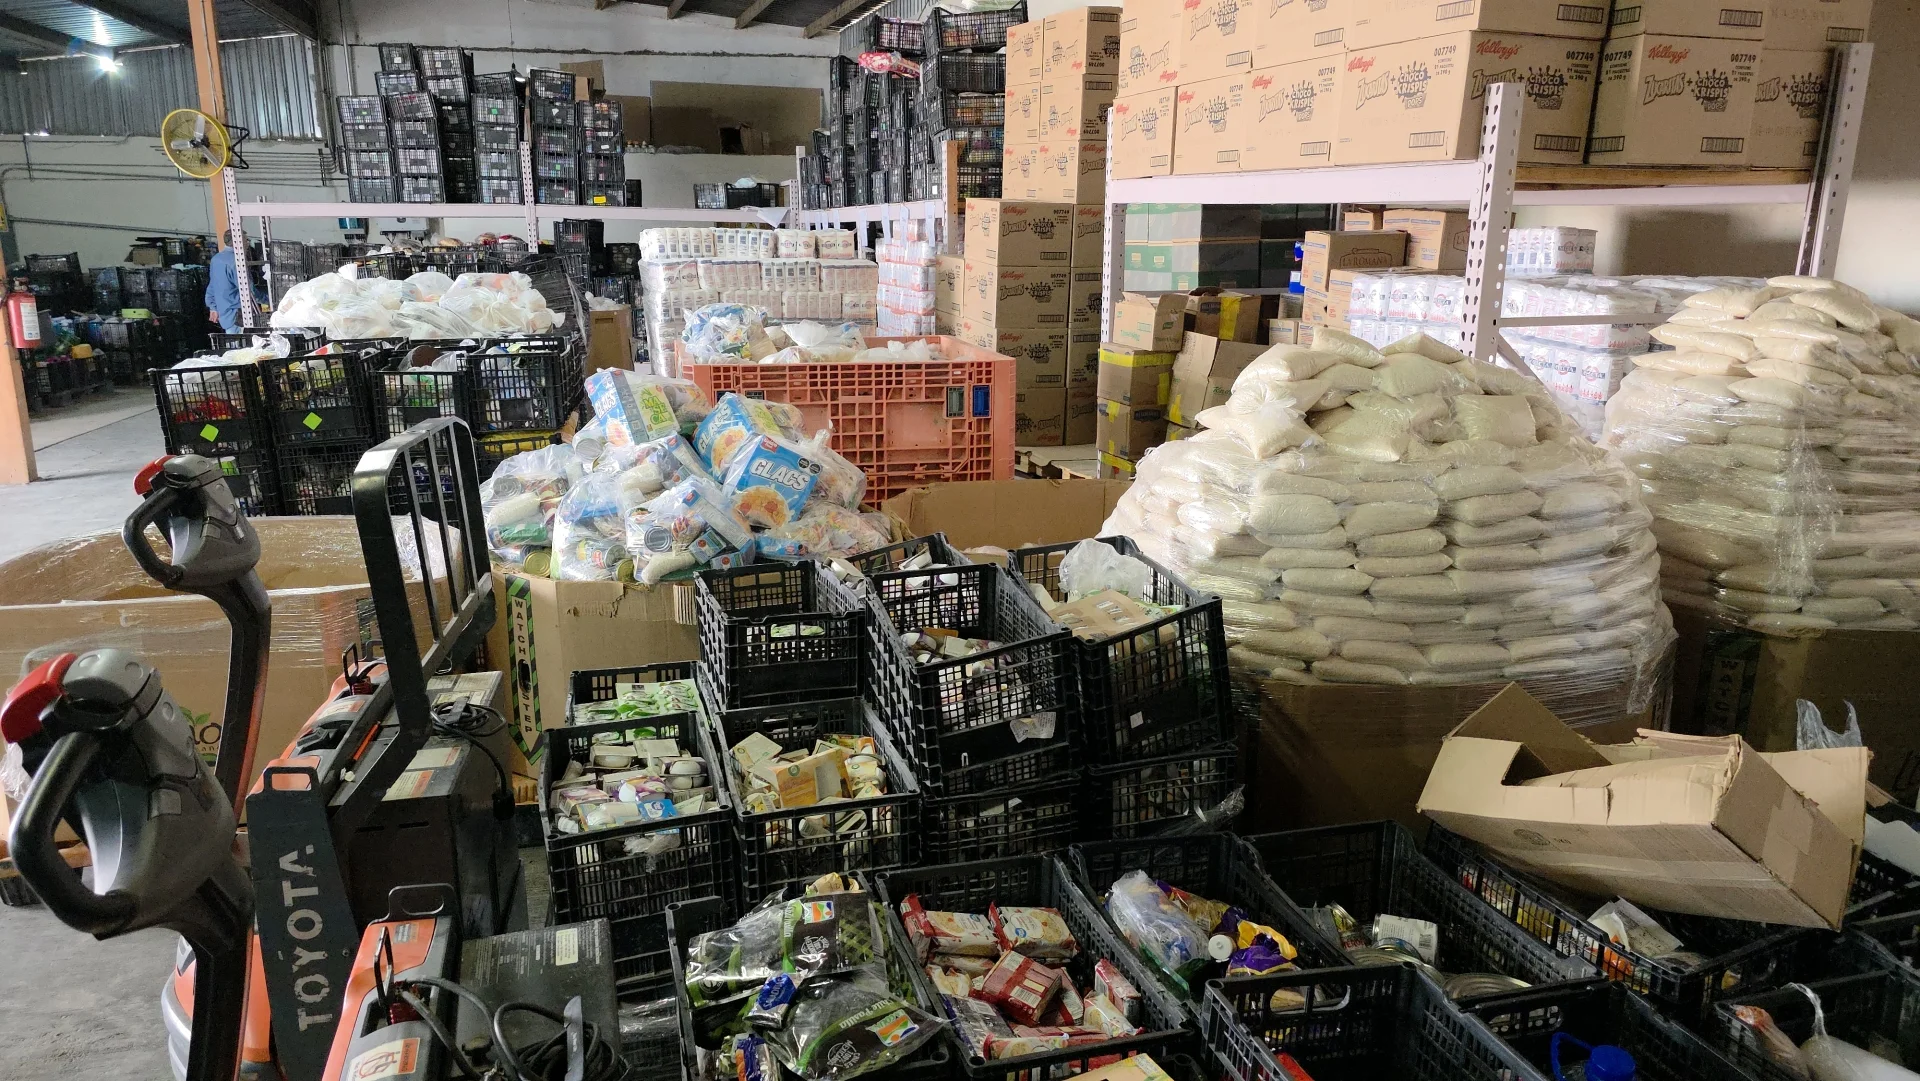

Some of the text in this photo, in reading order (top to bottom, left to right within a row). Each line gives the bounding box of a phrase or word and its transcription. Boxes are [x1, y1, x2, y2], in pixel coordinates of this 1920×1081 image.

[1434, 45, 1457, 57] 007749
[1566, 50, 1594, 62] 007749
[1605, 50, 1633, 62] 007749
[1730, 53, 1757, 63] 007749
[1397, 80, 1428, 95] KRISPIS
[1525, 82, 1565, 95] KRISPIS
[1694, 85, 1729, 98] KRISPIS
[1540, 98, 1559, 107] POPS
[1353, 256, 1389, 266] ROMANA
[750, 457, 811, 491] GLACS
[514, 600, 527, 655] WATCH
[279, 844, 333, 1032] TOYOTA
[840, 1008, 874, 1029] Pasilla
